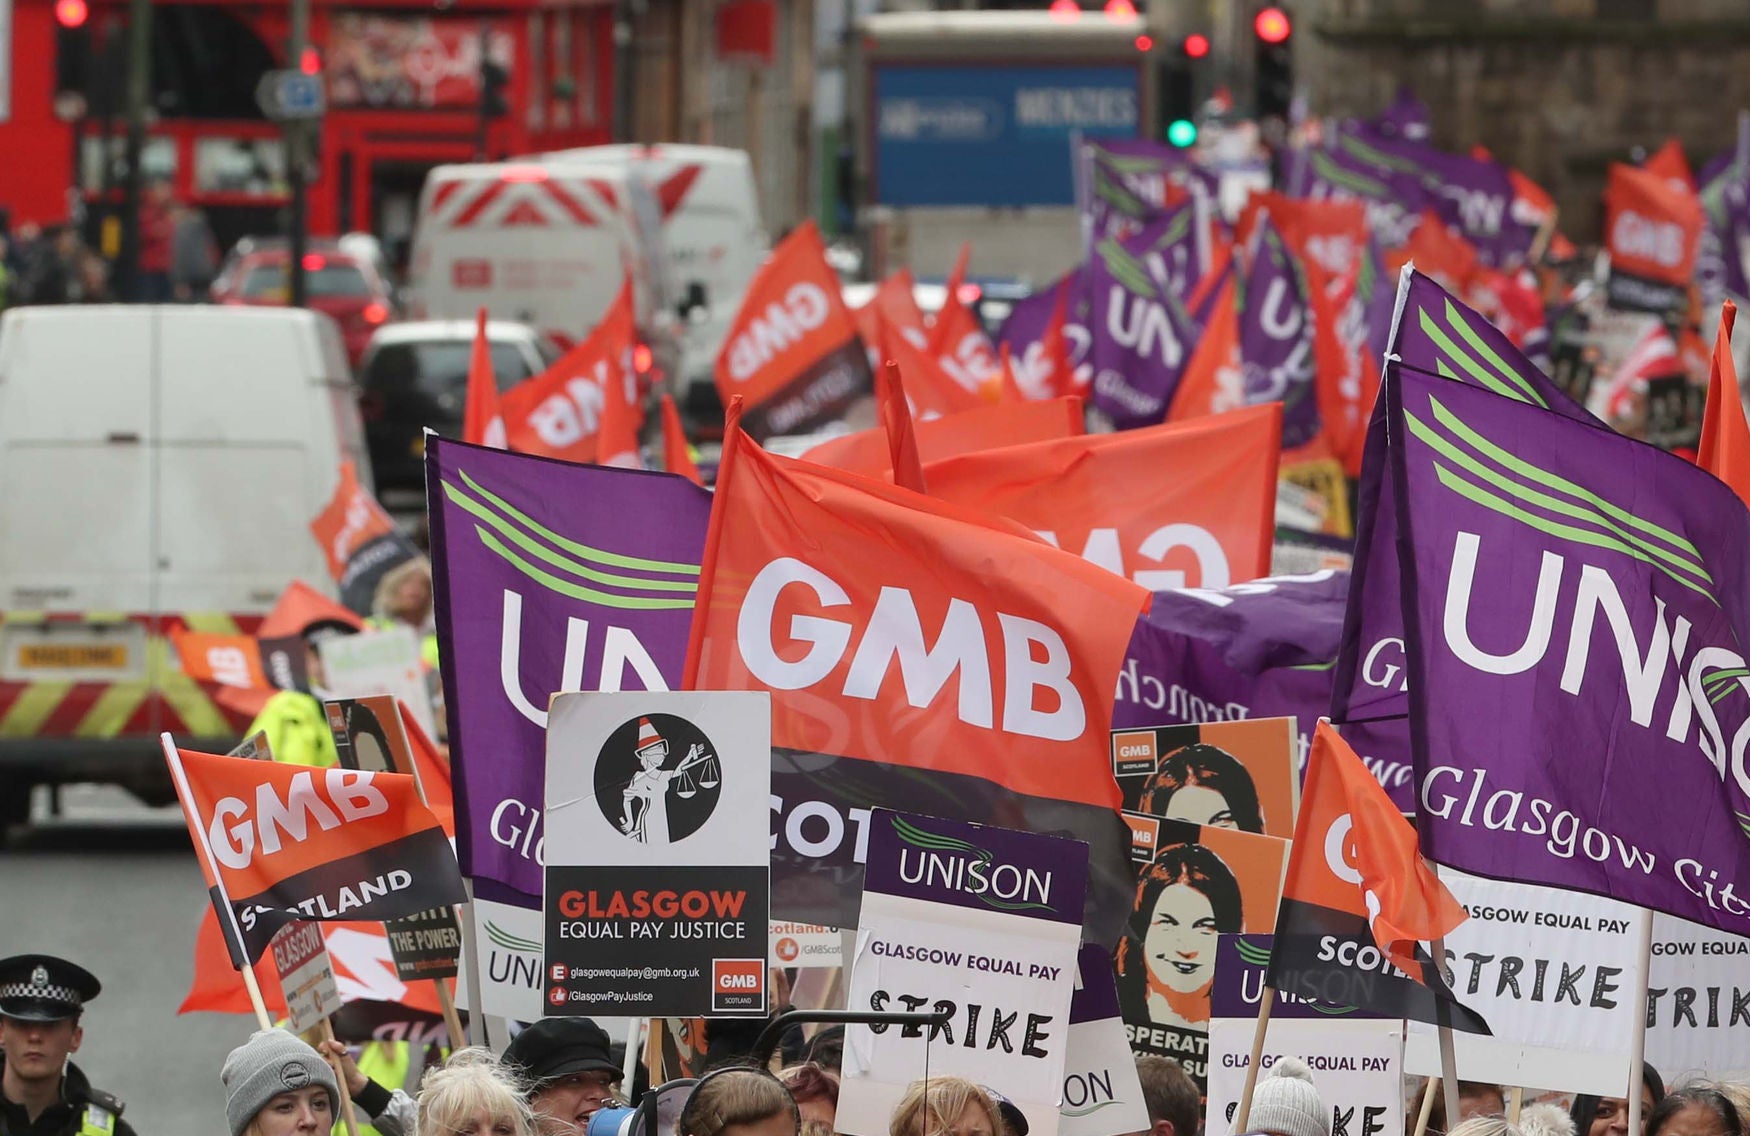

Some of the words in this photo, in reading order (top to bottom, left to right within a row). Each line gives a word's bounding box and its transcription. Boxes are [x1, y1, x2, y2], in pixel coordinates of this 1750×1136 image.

[736, 556, 1086, 742] GMB
[1119, 744, 1151, 758] GMB
[209, 768, 389, 870] GMB
[1421, 765, 1657, 875] Glasgow
[1132, 829, 1152, 843] MB
[899, 848, 1053, 905] UNISON
[558, 889, 748, 919] GLASGOW
[559, 921, 623, 939] EQUAL
[630, 921, 664, 938] PAY
[670, 921, 746, 939] JUSTICE
[1534, 911, 1592, 931] EQUAL
[1597, 918, 1631, 935] PAY
[274, 922, 322, 973] GLASGOW
[390, 931, 416, 952] THE
[415, 927, 460, 950] POWER
[570, 966, 700, 980] glasgowequalpay@gmb.org.uk
[871, 940, 963, 967] GLASGOW
[967, 955, 1023, 976] EQUAL
[1029, 964, 1062, 982] PAY
[719, 974, 757, 989] GMB
[568, 990, 654, 1003] /GlasgowPayJustice
[724, 997, 753, 1005] SCOTLAND
[868, 988, 1054, 1059] STRIKE
[1307, 1055, 1357, 1071] EQUAL
[1361, 1057, 1391, 1072] PAY
